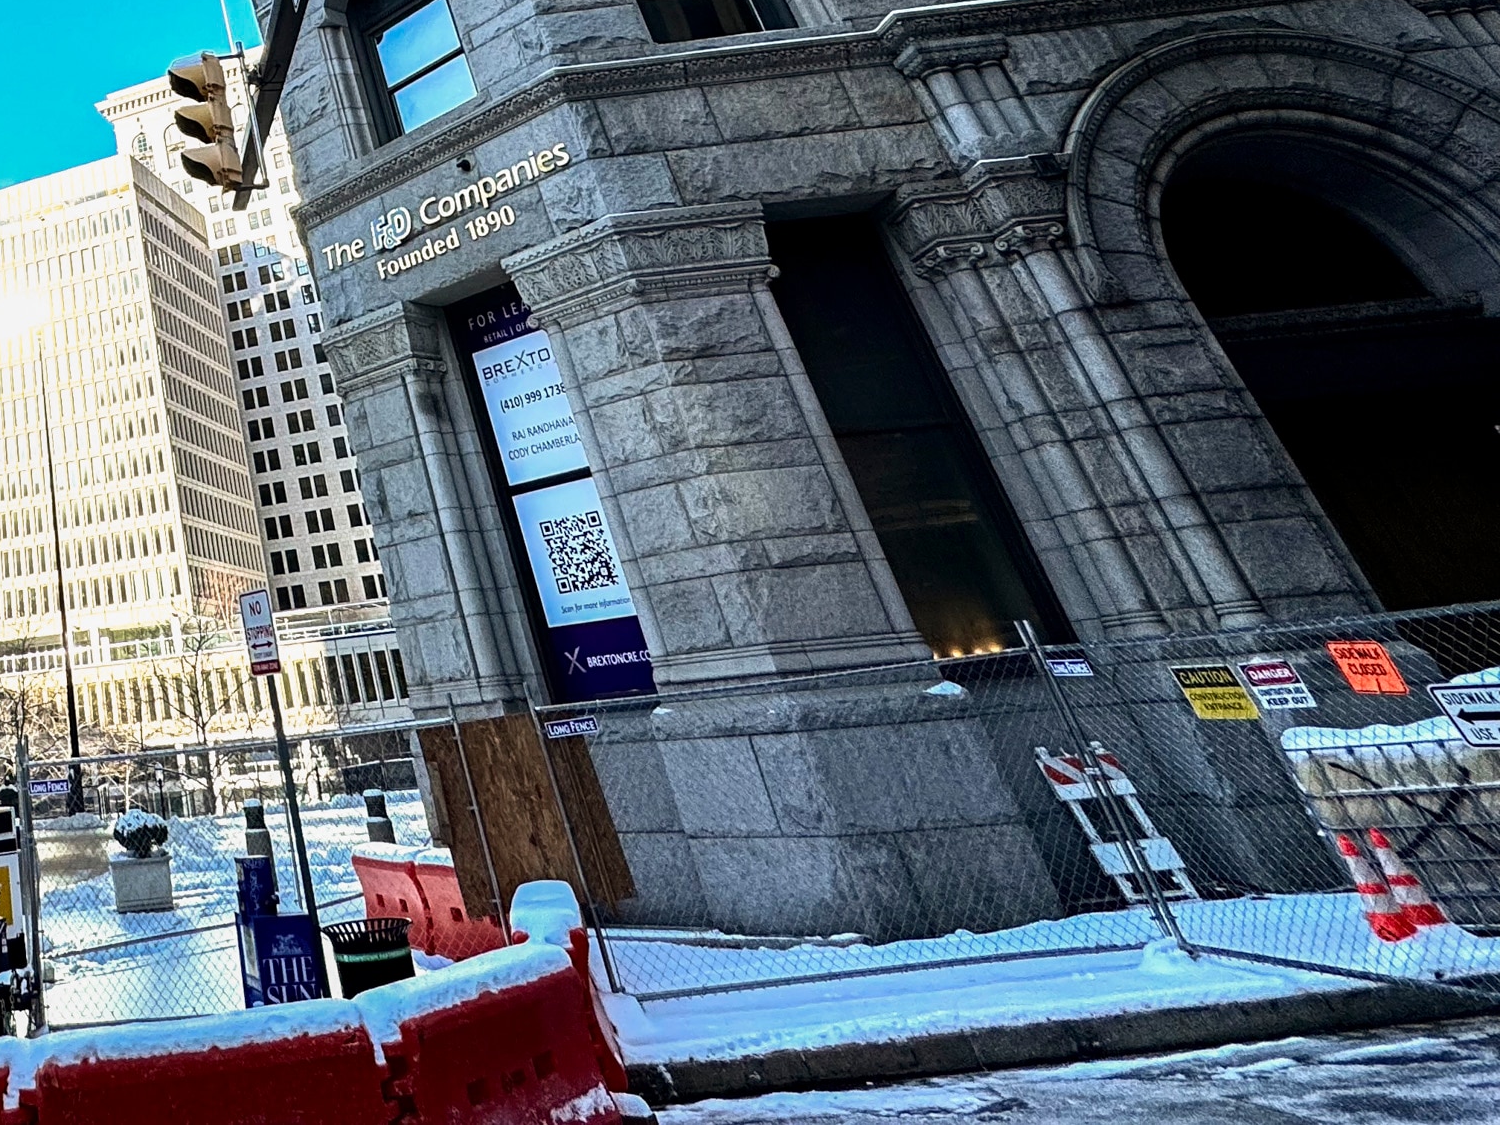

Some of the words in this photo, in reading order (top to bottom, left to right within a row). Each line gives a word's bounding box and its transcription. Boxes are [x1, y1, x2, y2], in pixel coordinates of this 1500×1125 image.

[321, 238, 365, 271] The
[419, 142, 571, 225] Companies
[376, 228, 460, 281] Founded
[464, 205, 516, 242] 1890
[467, 311, 496, 331] FOR
[483, 328, 509, 344] RETAIL
[482, 347, 551, 381] BREXTO
[500, 395, 524, 414] (410)
[524, 389, 542, 405] 999
[512, 428, 527, 442] RAJ
[526, 415, 575, 438] RANDHAWA
[508, 445, 530, 461] CODY
[248, 600, 262, 616] NO
[1334, 647, 1382, 660] SIDEWALK
[1248, 667, 1293, 681] DANGER
[1347, 662, 1388, 676] CLOSED
[1179, 670, 1234, 685] CAUTION
[1189, 691, 1246, 701] CONSTRUCTION
[1266, 697, 1290, 706] KEEP
[1292, 696, 1309, 705] OUT
[1441, 691, 1500, 706] SIDEWALK
[1203, 702, 1244, 711] ENTRANCE
[548, 724, 570, 736] LONG
[570, 720, 596, 733] FENCE
[1470, 727, 1498, 740] USE
[30, 782, 47, 793] LONG
[47, 781, 68, 792] FENCE
[262, 956, 316, 984] THE
